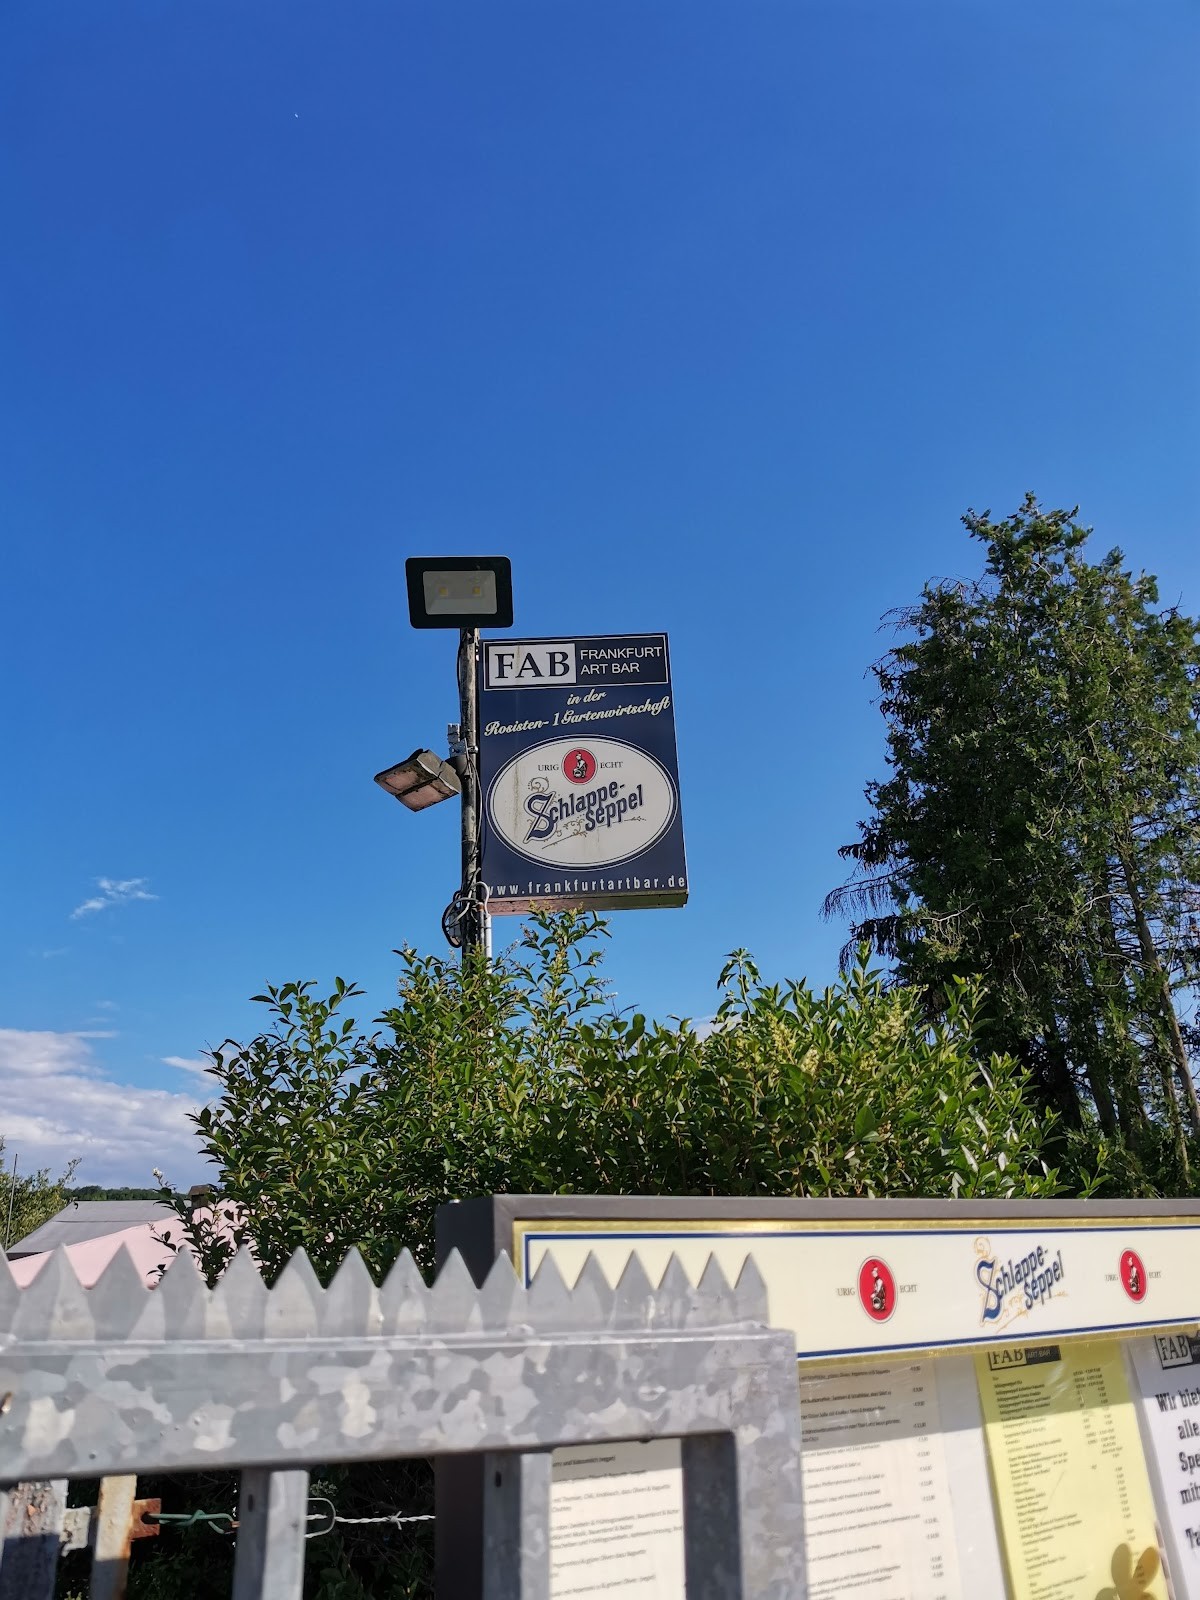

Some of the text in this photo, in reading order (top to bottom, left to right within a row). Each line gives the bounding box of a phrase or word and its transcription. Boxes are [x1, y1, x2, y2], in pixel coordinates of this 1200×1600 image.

[580, 646, 662, 660] FRANKFURT
[494, 651, 571, 679] FAB
[580, 662, 640, 675] ART BAR
[566, 688, 606, 705] in der
[560, 695, 671, 725] Gartenwirtschaft
[537, 761, 623, 772] URIG ECHT
[837, 1284, 918, 1297] URIG ECHT
[1157, 1335, 1189, 1361] FAB
[1155, 1391, 1177, 1412] Wir
